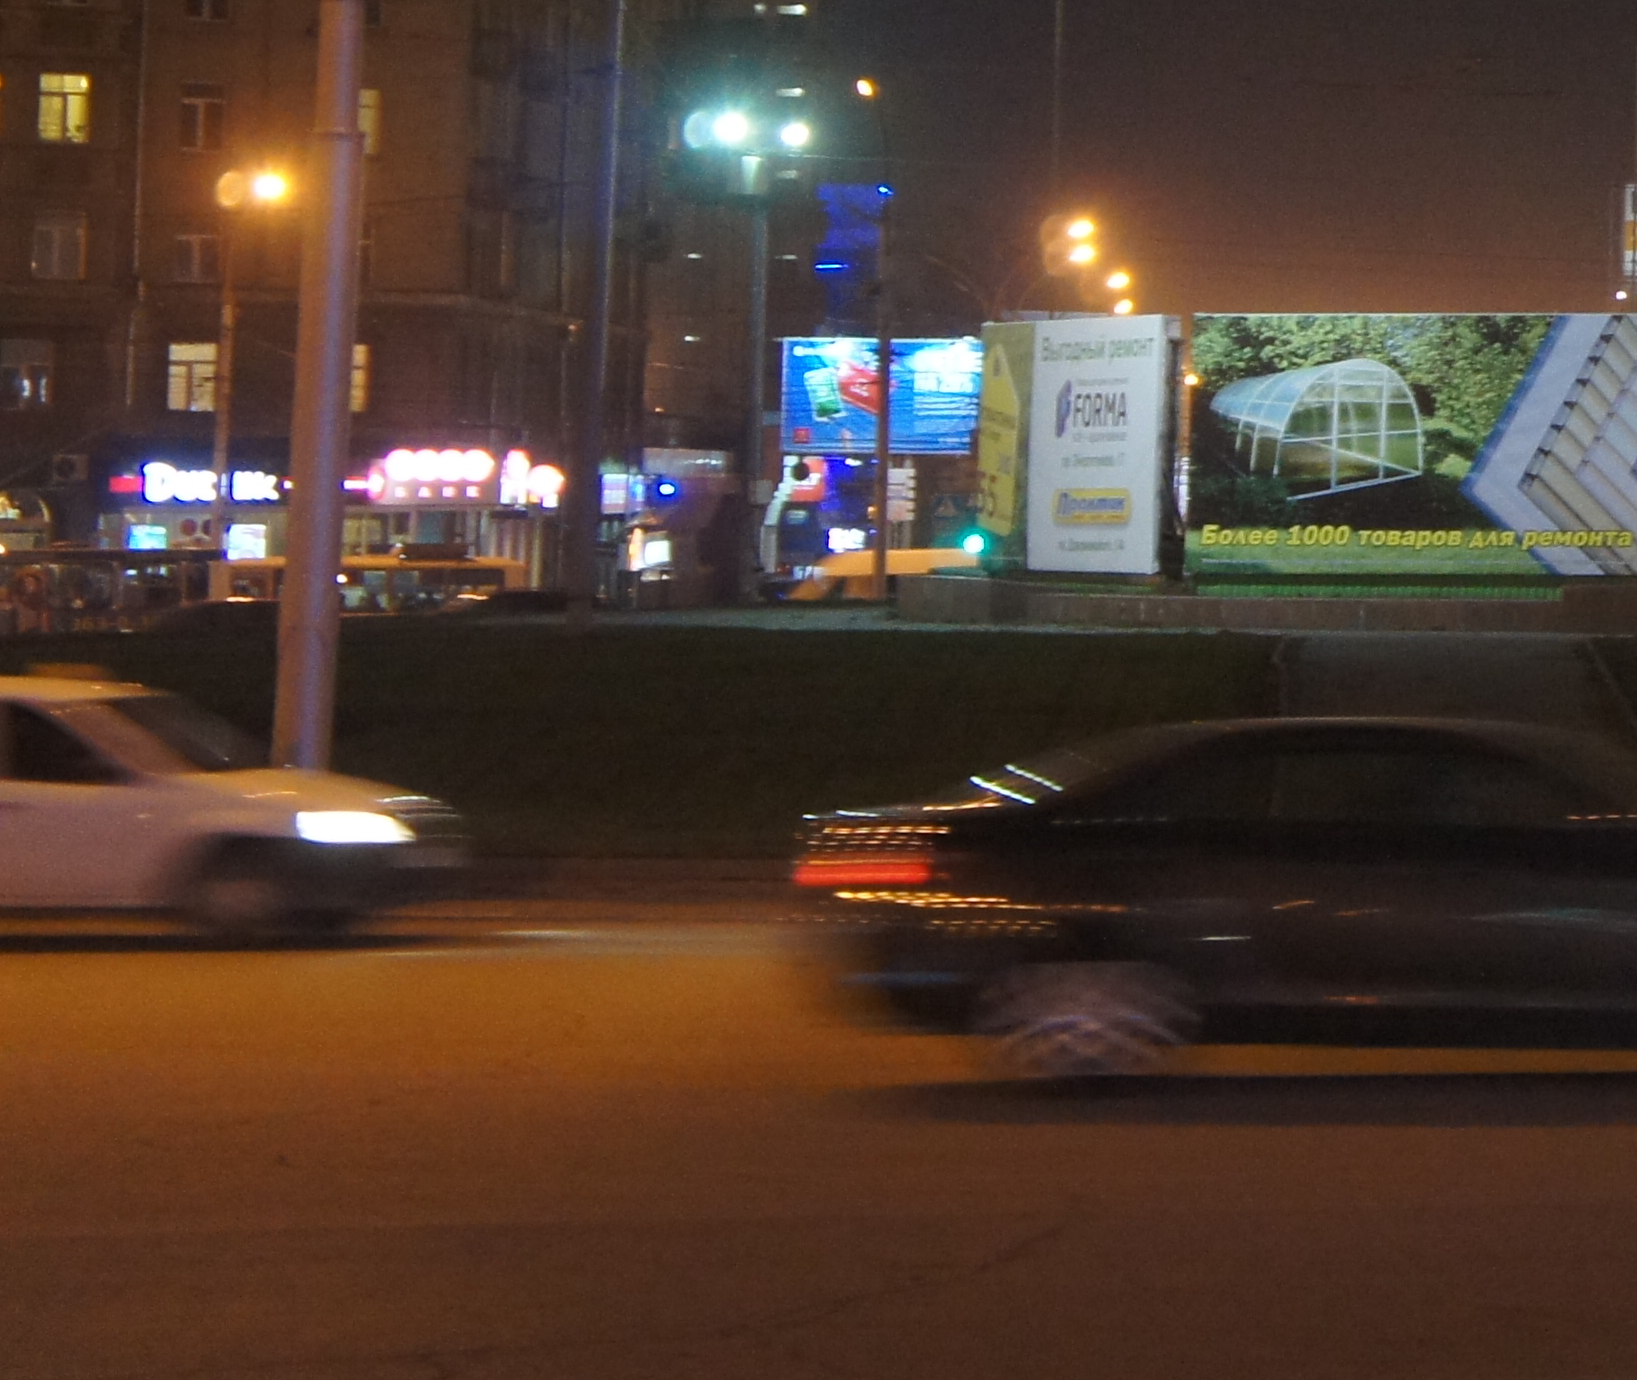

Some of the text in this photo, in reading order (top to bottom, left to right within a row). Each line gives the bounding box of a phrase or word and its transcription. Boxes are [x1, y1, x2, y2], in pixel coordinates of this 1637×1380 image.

[1073, 391, 1128, 429] FORMA
[1201, 523, 1634, 551] Более 1000 товаров для ремонта
